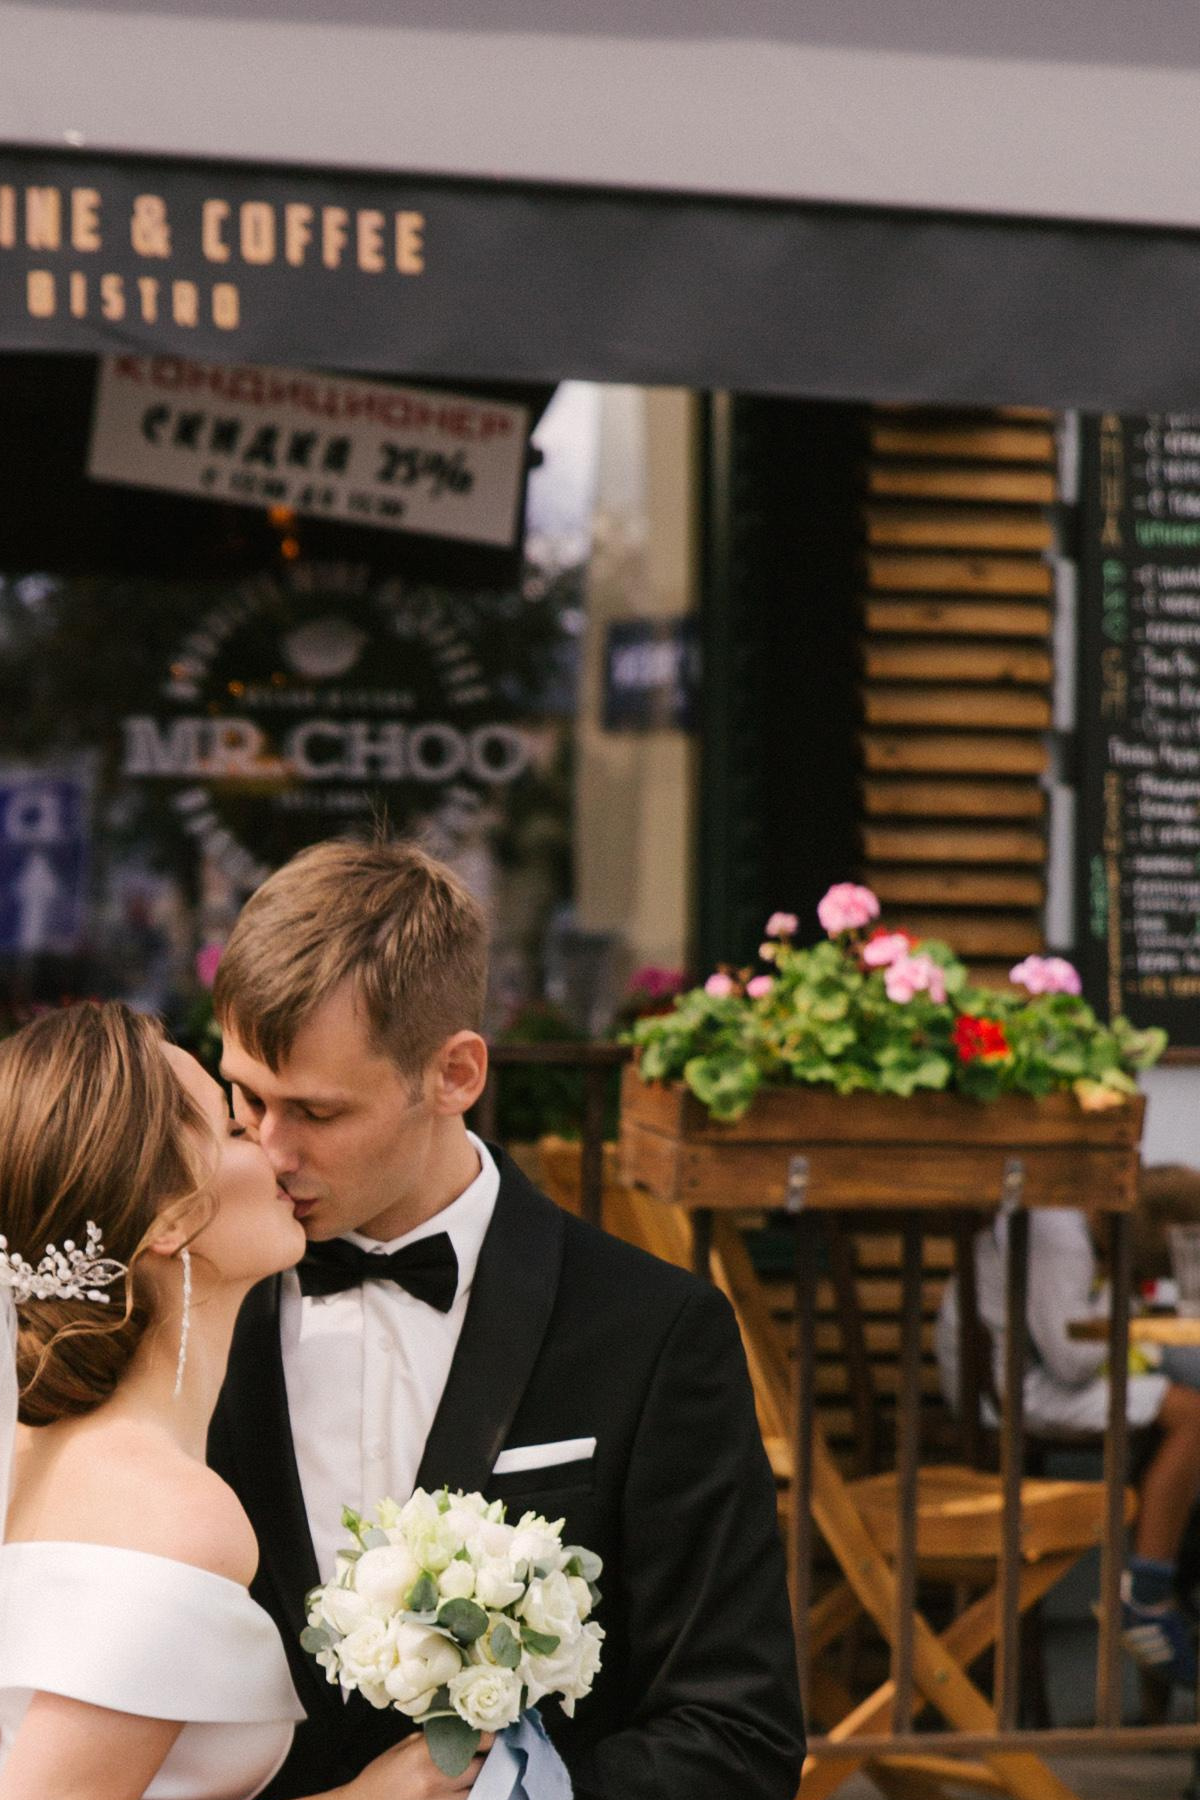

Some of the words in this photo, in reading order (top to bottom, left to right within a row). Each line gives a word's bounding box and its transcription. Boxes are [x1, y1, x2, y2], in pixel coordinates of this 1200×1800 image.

[130, 194, 173, 260] &
[201, 198, 426, 277] COFFEE
[26, 269, 241, 332] BISTRO
